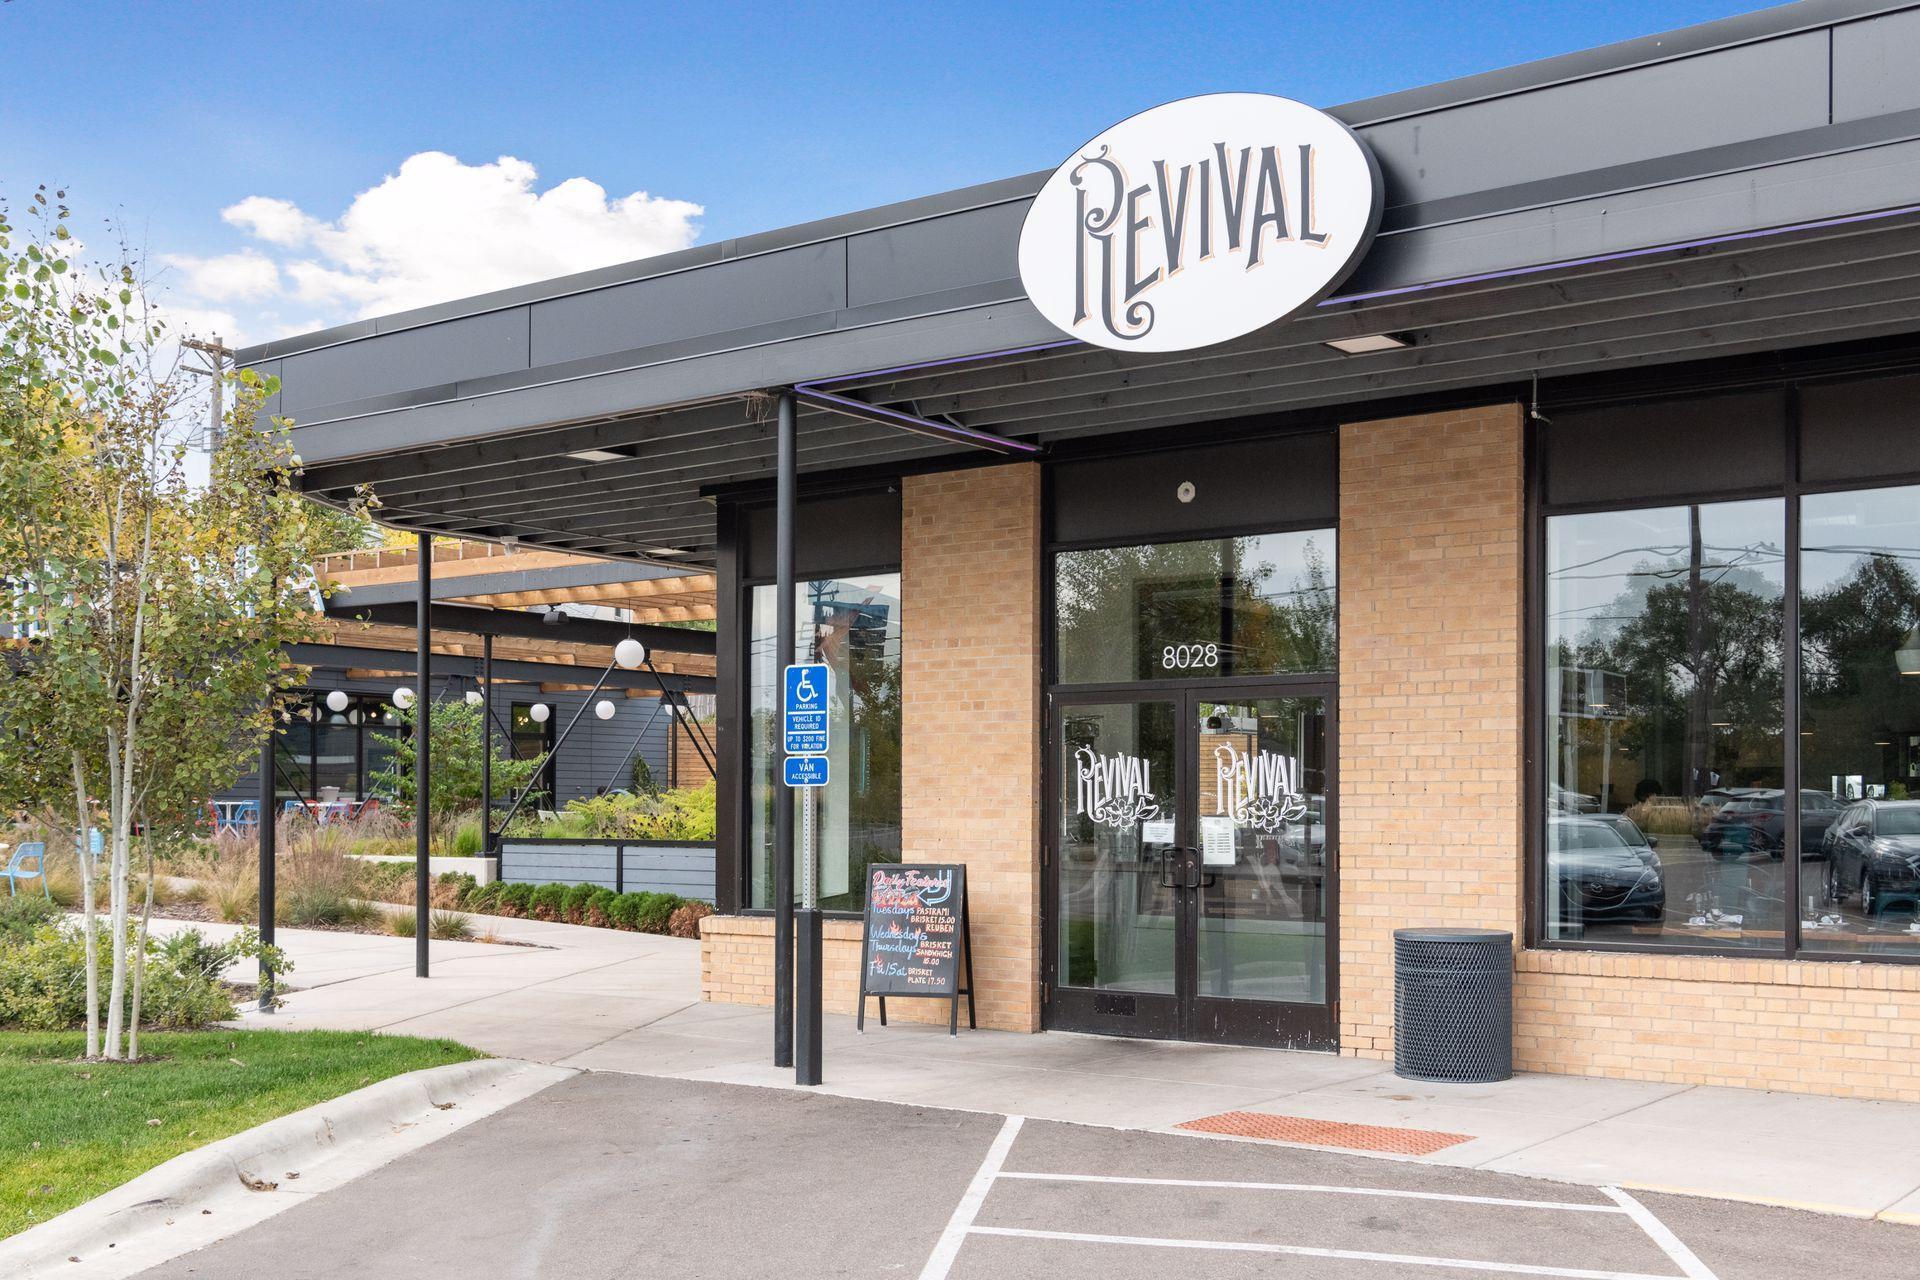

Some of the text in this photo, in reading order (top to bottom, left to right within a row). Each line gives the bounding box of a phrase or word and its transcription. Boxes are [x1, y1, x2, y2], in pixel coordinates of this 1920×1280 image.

[1070, 142, 1331, 340] REVIVAL
[1162, 643, 1219, 669] 8028
[792, 715, 813, 723] VEHICLE
[787, 735, 793, 743] UP
[802, 735, 814, 743] $200
[799, 763, 815, 772] VAN
[791, 772, 822, 780] ACCESSIBLE
[1075, 744, 1156, 823] REVIVAL
[1214, 741, 1304, 824] REVIVAL
[872, 870, 904, 890] Daily
[916, 907, 950, 916] PASTRAMI
[910, 915, 937, 923] BRISKET
[925, 924, 954, 933] REUBEN
[869, 925, 928, 947] Wednesdays
[920, 941, 952, 949] BRISKET
[869, 940, 917, 960] Thursdays
[907, 967, 933, 976] BRISKET
[927, 977, 946, 985] 17.50
